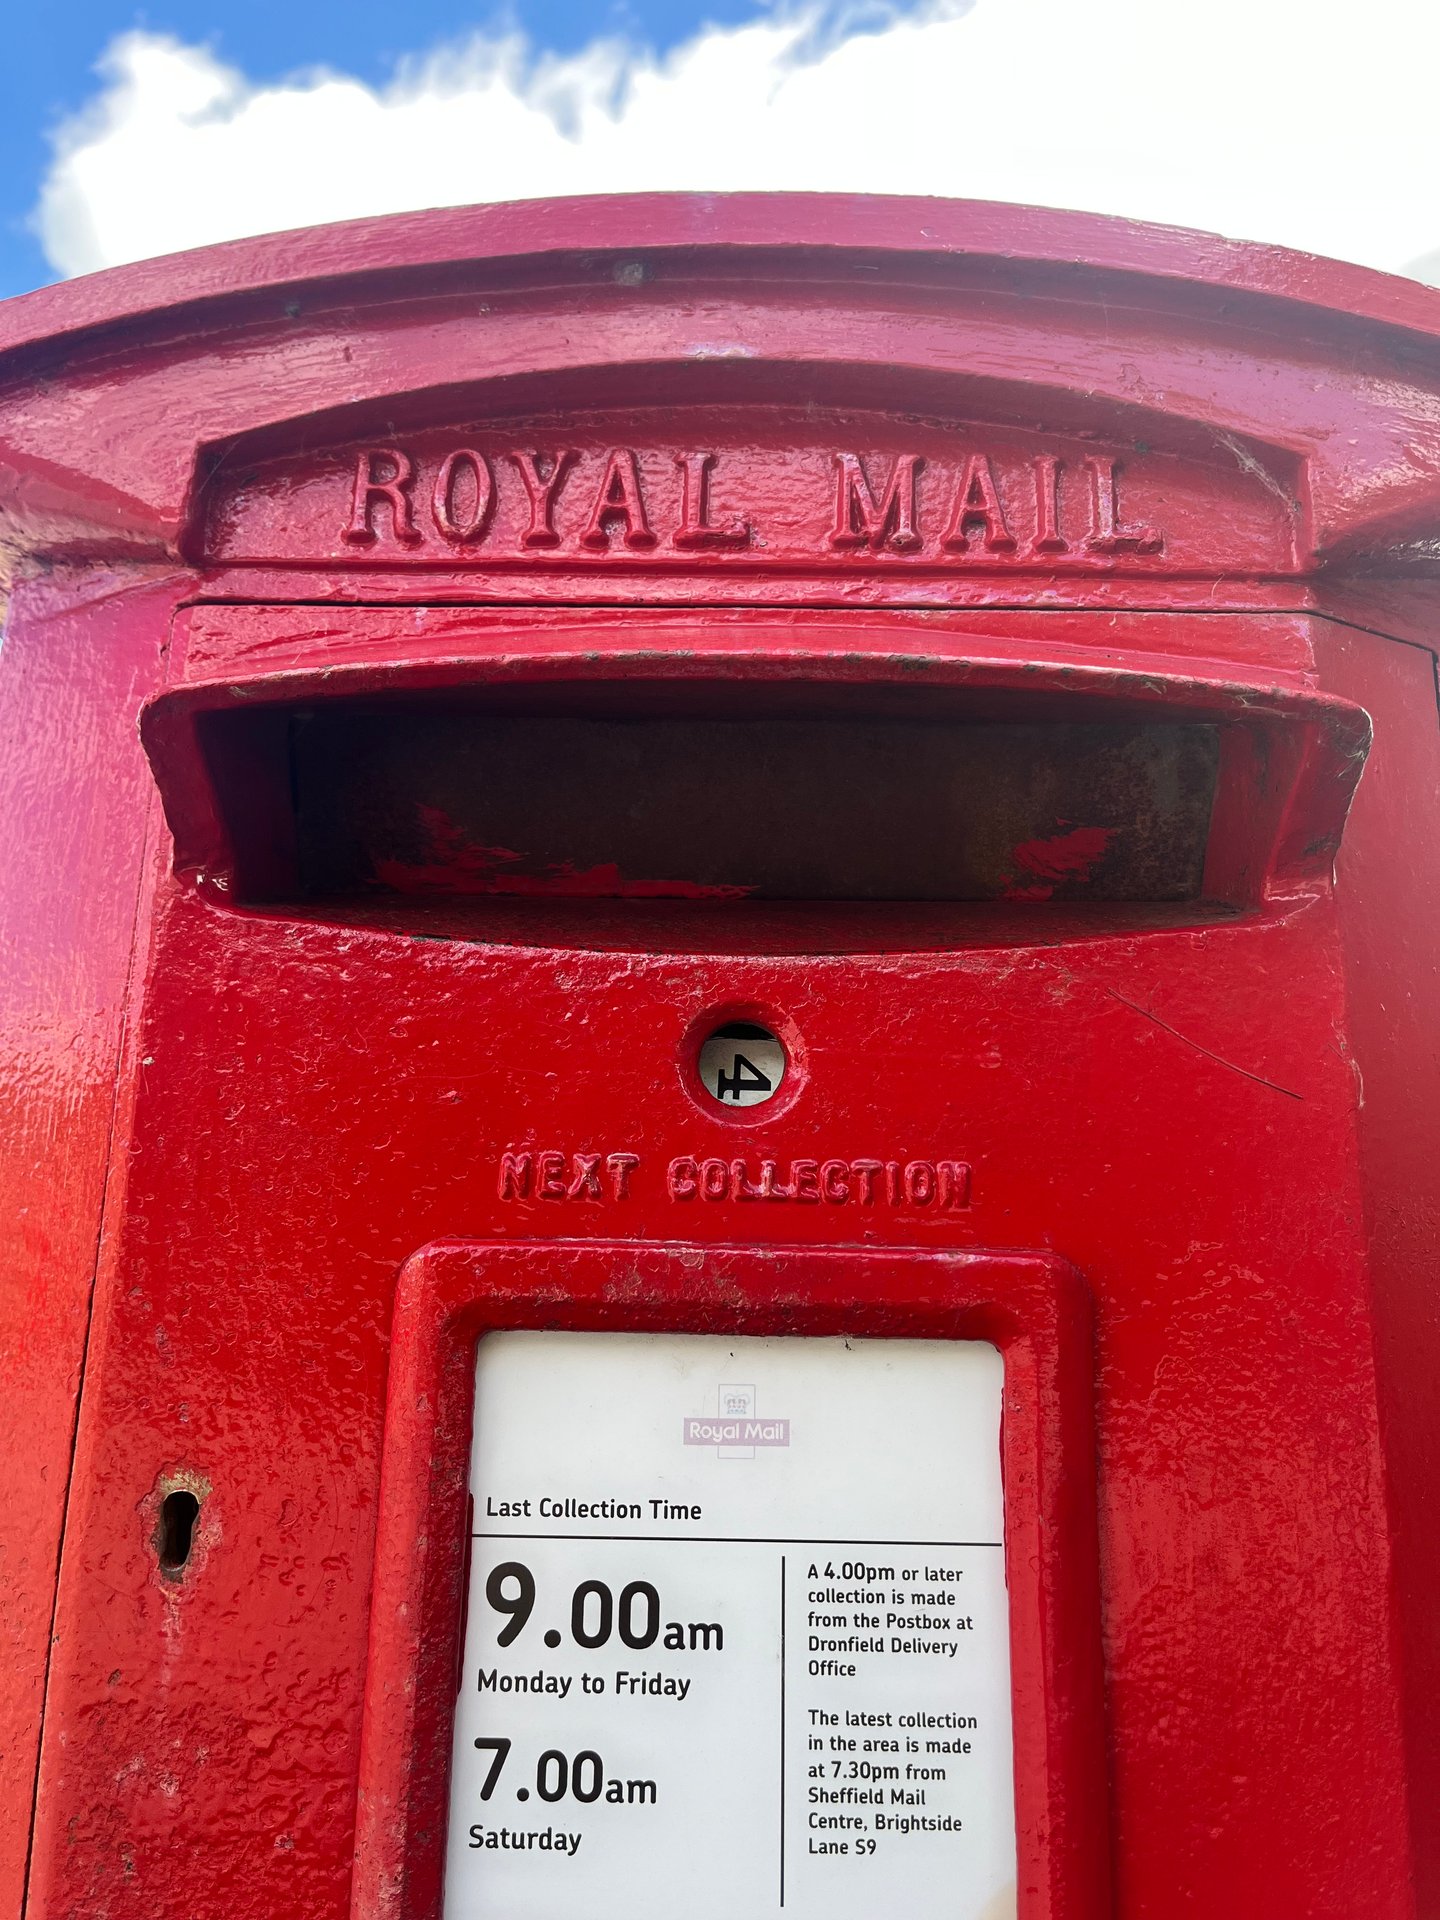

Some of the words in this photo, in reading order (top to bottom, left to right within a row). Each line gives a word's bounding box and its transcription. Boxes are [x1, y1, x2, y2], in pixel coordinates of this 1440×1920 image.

[340, 448, 752, 548] ROYAL
[828, 452, 1165, 554] MAIL
[717, 1053, 772, 1100] 4
[499, 1151, 641, 1201] NEXT
[667, 1155, 974, 1211] COLLECTION
[689, 1421, 740, 1443] Royal
[744, 1422, 784, 1440] Mail
[486, 1496, 532, 1517] Last
[539, 1497, 642, 1519] Collection
[648, 1499, 702, 1521] Time
[807, 1563, 819, 1580] A
[823, 1561, 895, 1585] 4.00pm
[901, 1569, 920, 1581] or
[924, 1566, 964, 1582] later
[808, 1587, 886, 1604] collection
[891, 1588, 905, 1605] is
[910, 1590, 956, 1606] made
[807, 1611, 847, 1628] from
[852, 1612, 880, 1629] the
[886, 1612, 951, 1630] Postbox
[956, 1615, 974, 1631] at
[808, 1635, 885, 1653] Dronfield
[891, 1637, 958, 1658] Delivery
[808, 1659, 856, 1677] Office
[477, 1668, 573, 1699] Monday
[580, 1672, 605, 1695] to
[615, 1671, 691, 1702] Friday
[807, 1709, 839, 1726] The
[845, 1710, 893, 1727] latest
[898, 1711, 978, 1729] collection
[808, 1734, 823, 1751] in
[829, 1734, 857, 1752] the
[862, 1739, 900, 1753] area
[906, 1736, 920, 1753] is
[925, 1737, 972, 1754] made
[473, 1737, 657, 1805] 7.00am
[808, 1763, 826, 1778] at
[830, 1760, 900, 1783] 7.30pm
[905, 1763, 946, 1781] from
[808, 1786, 884, 1805] Sheffield
[890, 1788, 926, 1806] Mail
[808, 1812, 868, 1832] Centre,
[875, 1813, 962, 1834] Brightside
[468, 1824, 582, 1857] Saturday
[808, 1837, 849, 1855] Lane
[855, 1838, 877, 1856] S9
